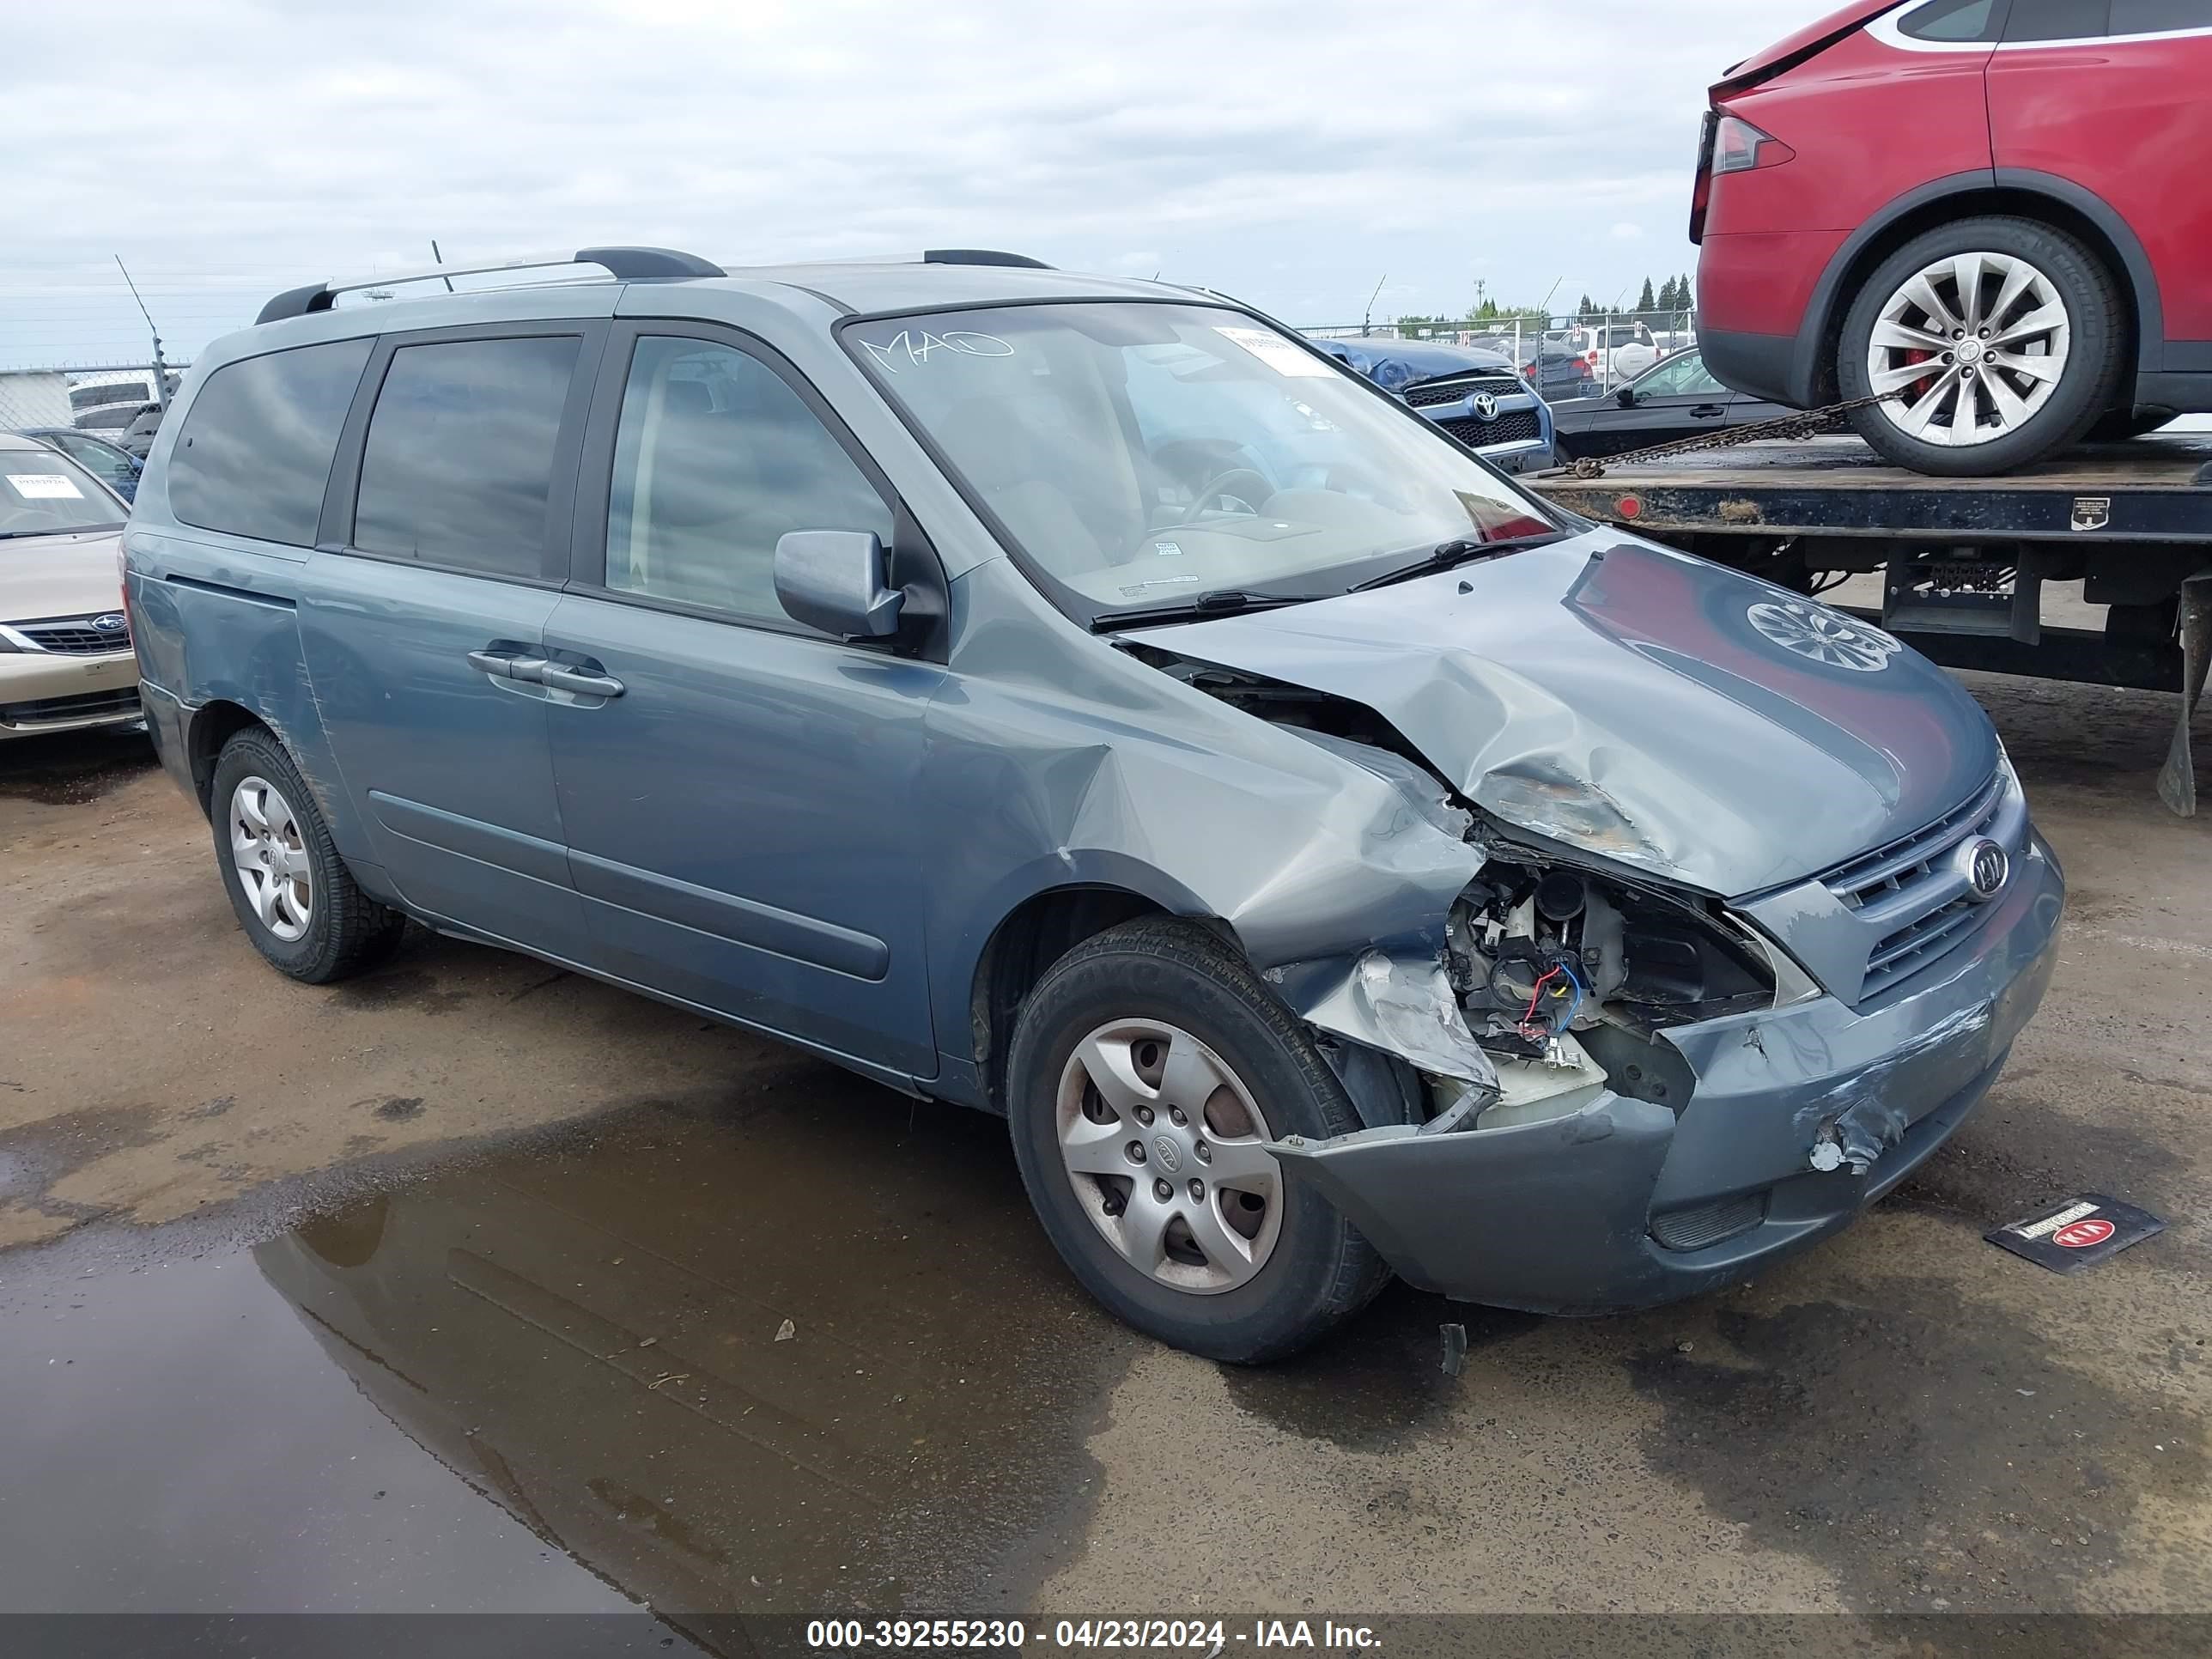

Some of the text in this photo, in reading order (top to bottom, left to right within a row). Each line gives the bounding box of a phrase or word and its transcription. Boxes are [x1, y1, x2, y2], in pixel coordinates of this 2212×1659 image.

[1573, 325, 1581, 337] 13
[1634, 322, 1642, 335] 14
[858, 330, 1015, 374] MAD
[2057, 1224, 2107, 1244] KIA
